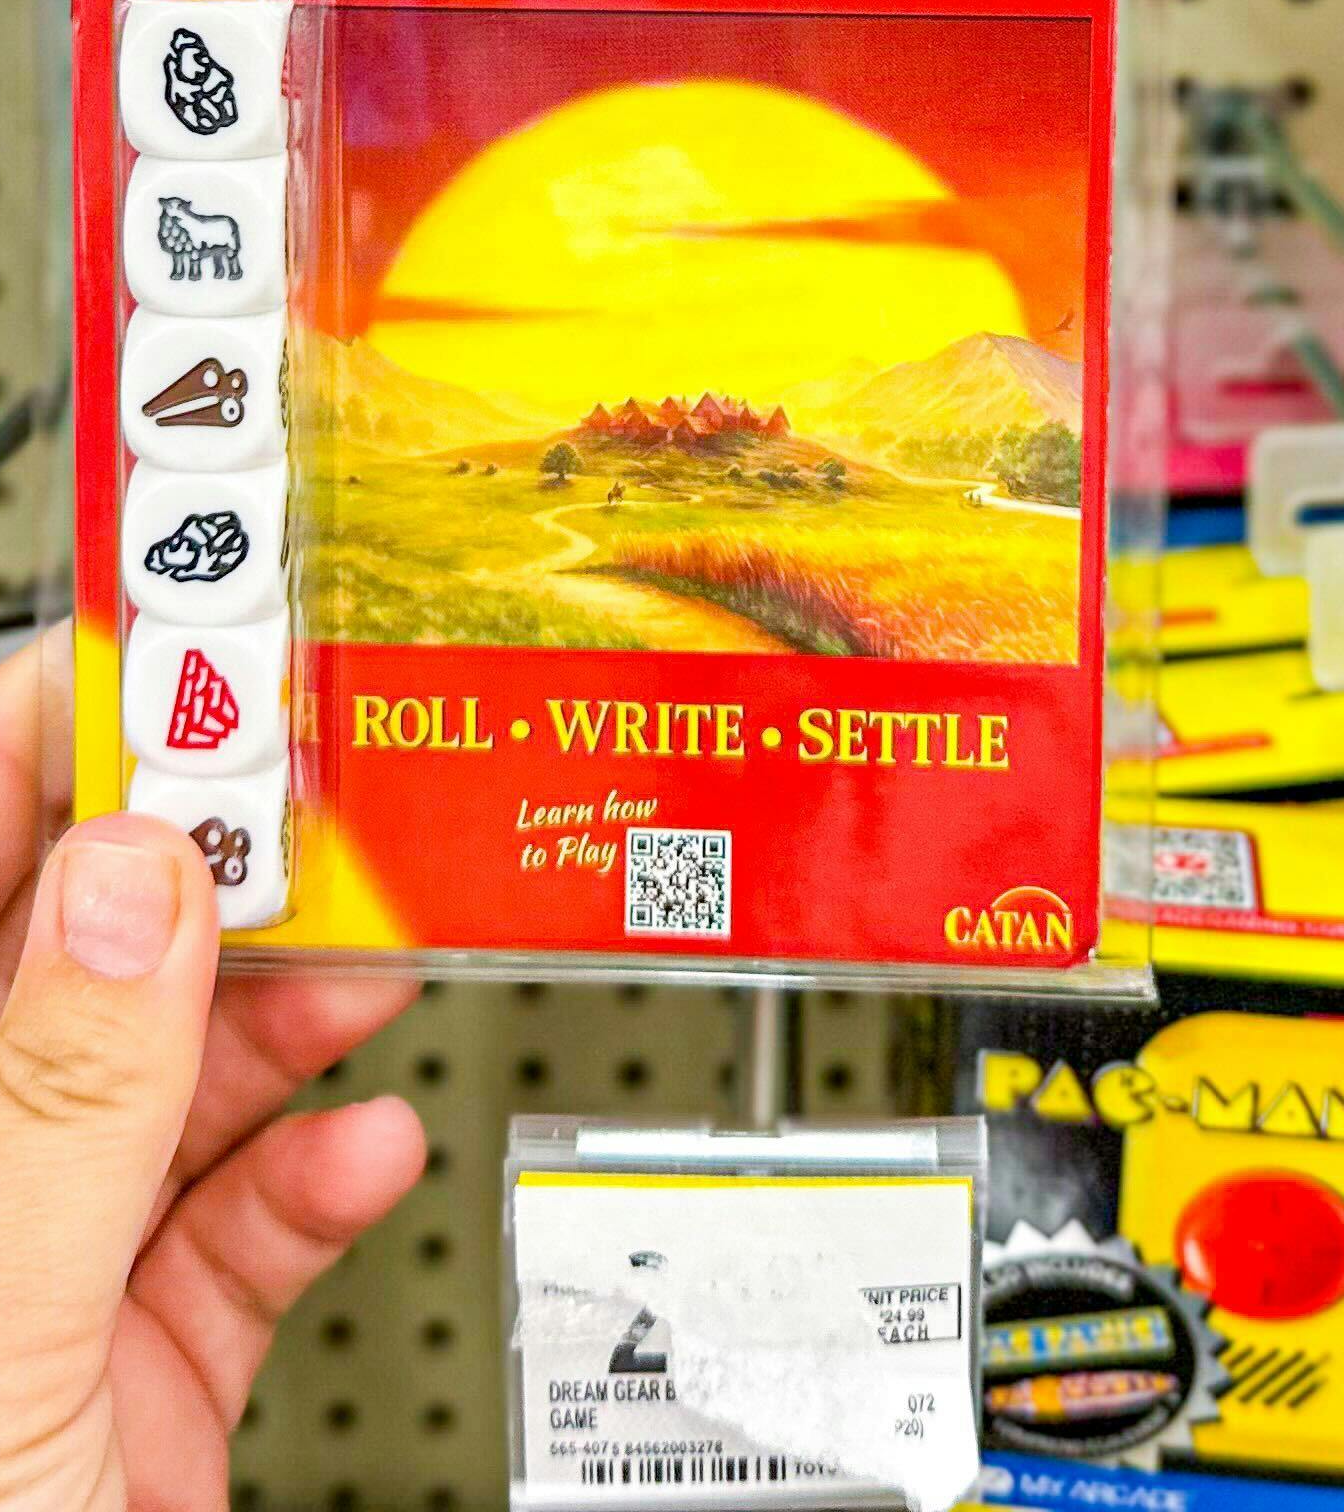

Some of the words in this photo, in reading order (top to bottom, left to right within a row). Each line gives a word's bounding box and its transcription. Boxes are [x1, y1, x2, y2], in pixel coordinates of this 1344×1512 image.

[352, 694, 494, 751] ROLL
[545, 697, 746, 760] WRITE
[796, 706, 1011, 770] SETTLE
[515, 796, 594, 832] Learn
[602, 788, 659, 823] how
[520, 840, 549, 870] to
[554, 832, 619, 876] Play
[943, 904, 1074, 954] CATAN
[862, 1288, 895, 1305] NIT
[898, 1287, 950, 1304] PRICE
[549, 1380, 608, 1403] DREAM
[613, 1379, 661, 1402] GEAR
[549, 1407, 599, 1431] GAME
[1018, 1471, 1065, 1498] MY
[1068, 1476, 1189, 1512] ARCADE
